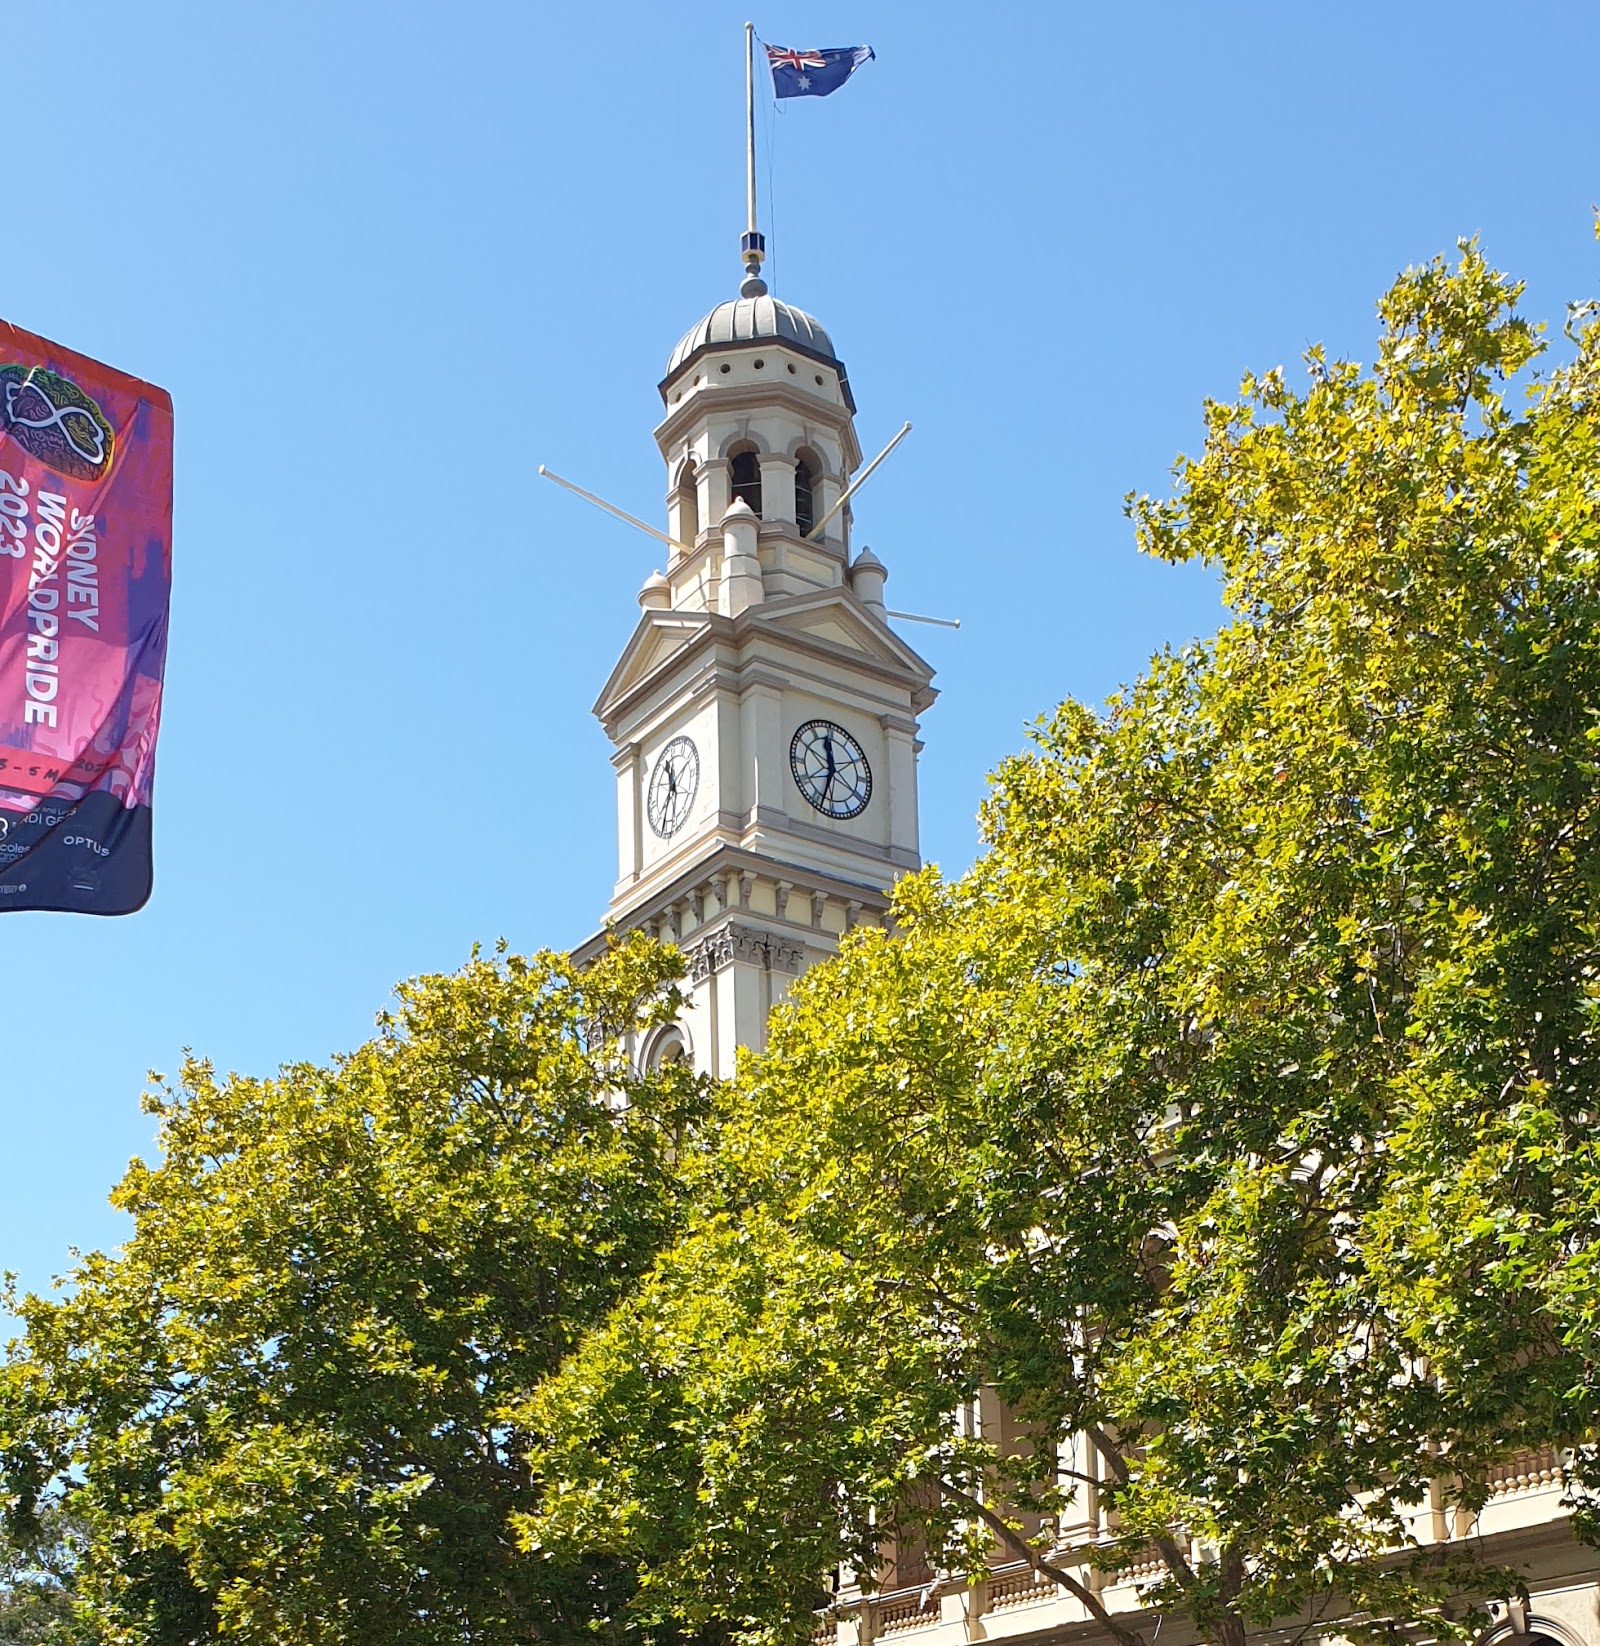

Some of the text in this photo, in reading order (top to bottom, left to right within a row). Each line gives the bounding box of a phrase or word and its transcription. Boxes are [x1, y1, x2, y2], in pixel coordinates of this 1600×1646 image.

[0, 469, 30, 559] 2023
[24, 490, 67, 728] WORLDPRIDE
[66, 507, 99, 632] SYDNEY
[63, 835, 110, 856] OPTUS
